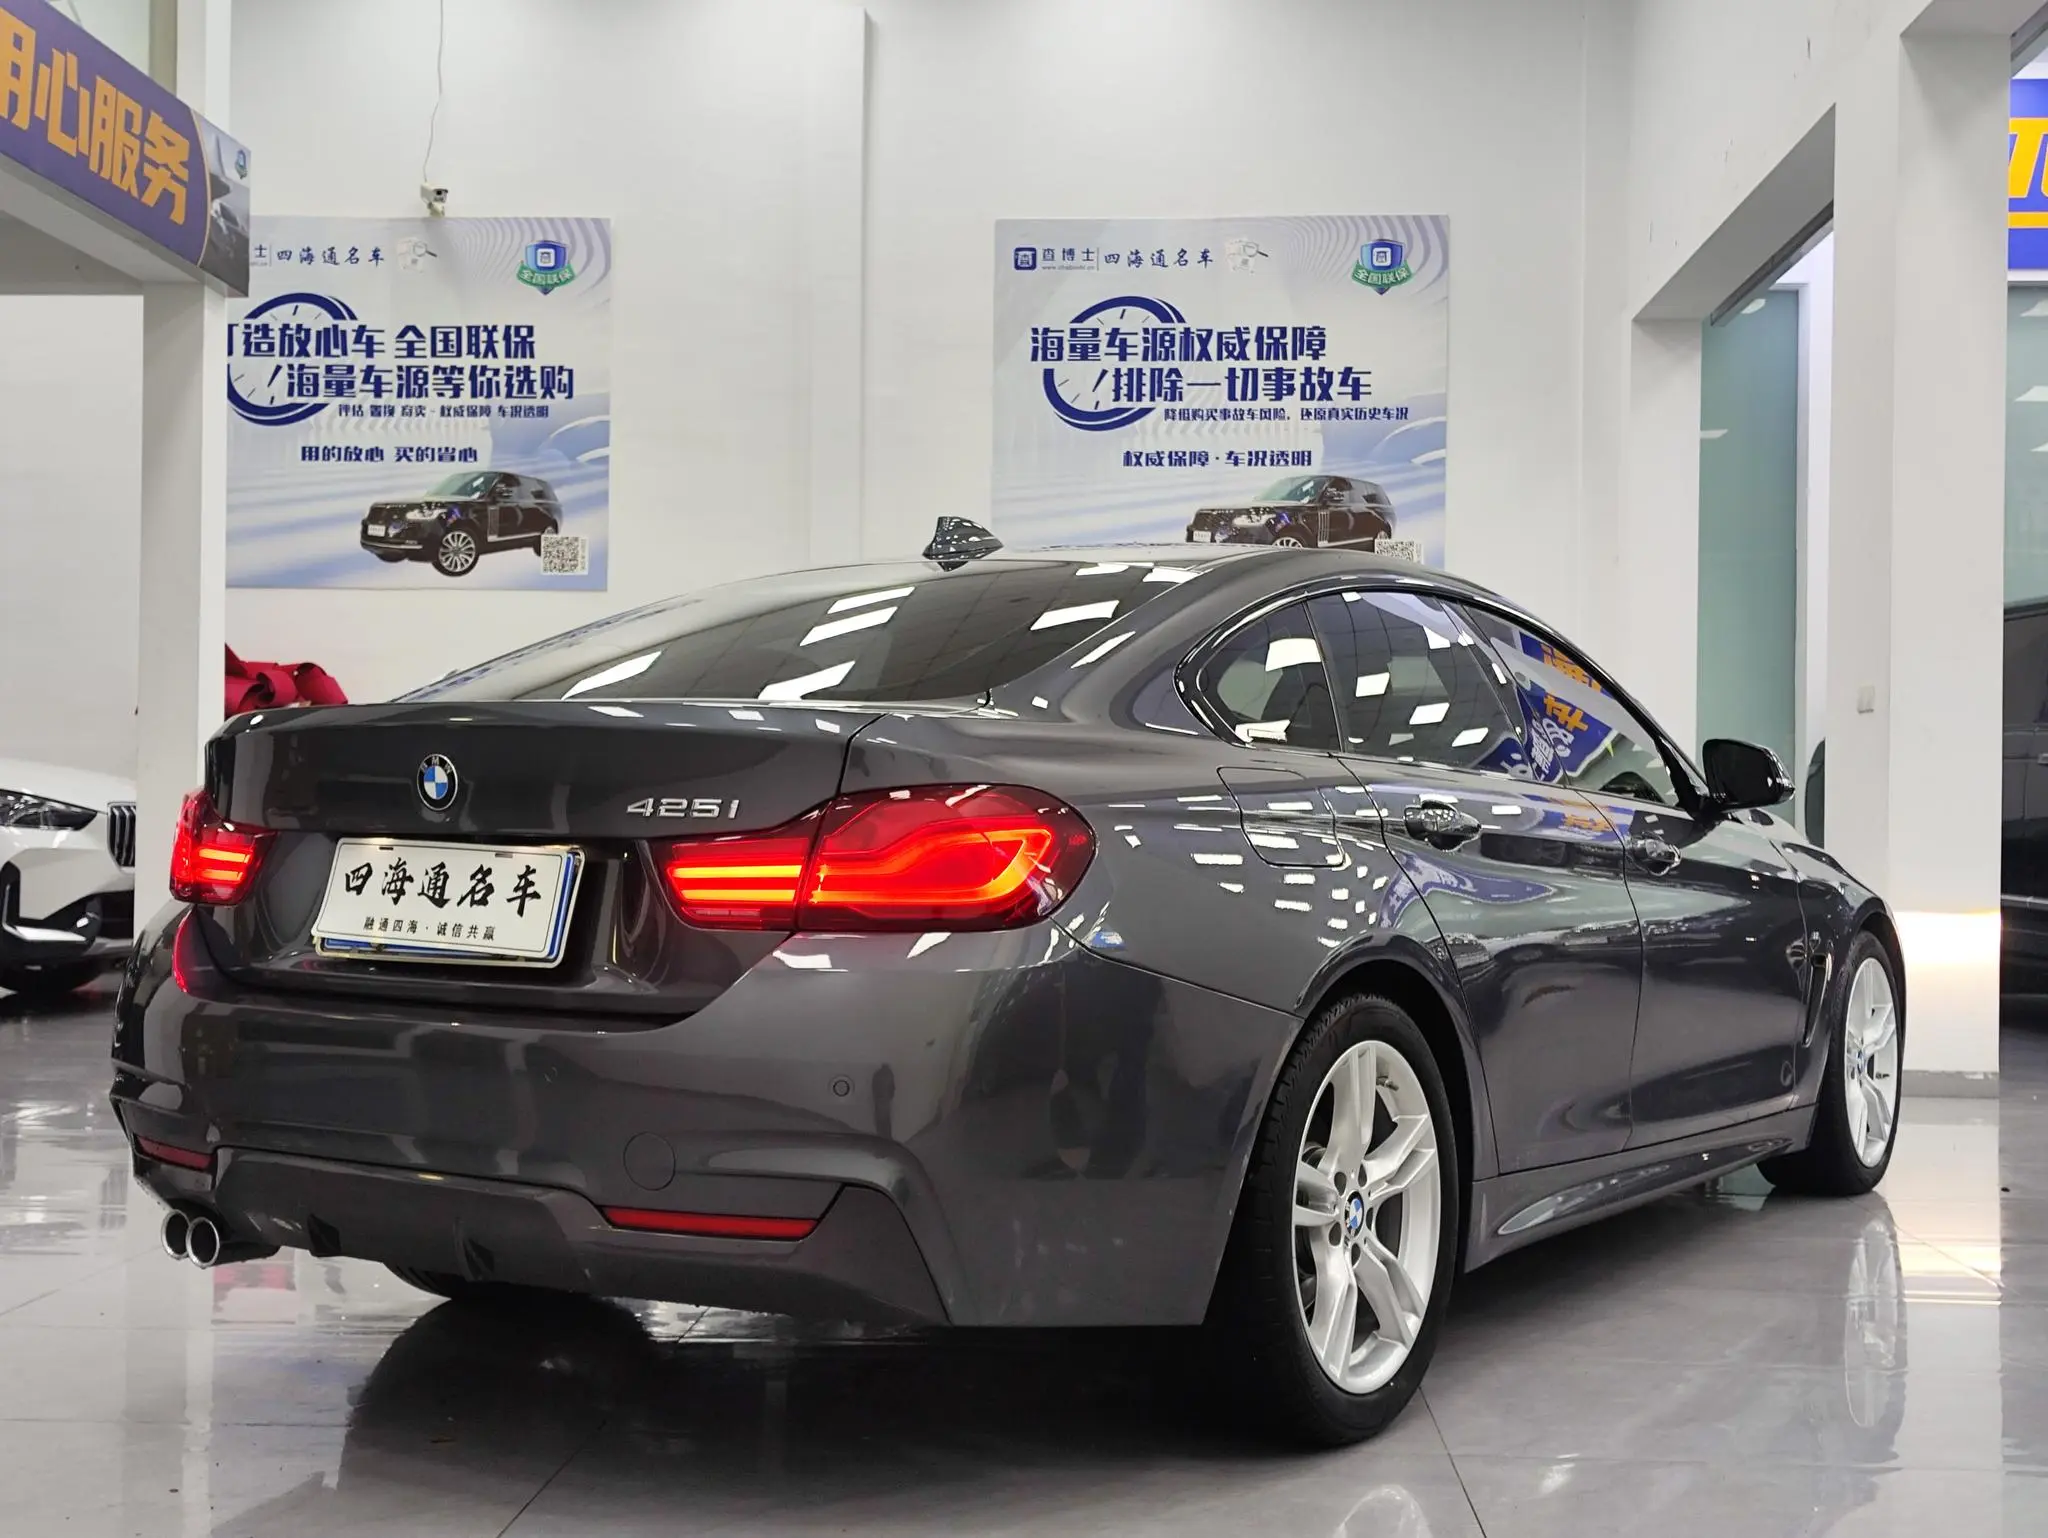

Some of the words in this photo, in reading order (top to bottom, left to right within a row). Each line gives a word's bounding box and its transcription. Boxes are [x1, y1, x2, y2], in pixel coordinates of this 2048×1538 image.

[276, 246, 384, 267] 四海通名车
[1104, 248, 1214, 269] 四海通名车
[1354, 267, 1410, 285] 全国联保
[394, 324, 535, 359] 全国联保
[1030, 326, 1327, 362] 海量车源权威保障
[287, 363, 574, 400] 海量车源等你选购
[1112, 366, 1373, 402] 排除一切事故车
[301, 446, 384, 462] 用的放心
[394, 446, 478, 463] 买的省心
[344, 857, 542, 918] 四海通名车
